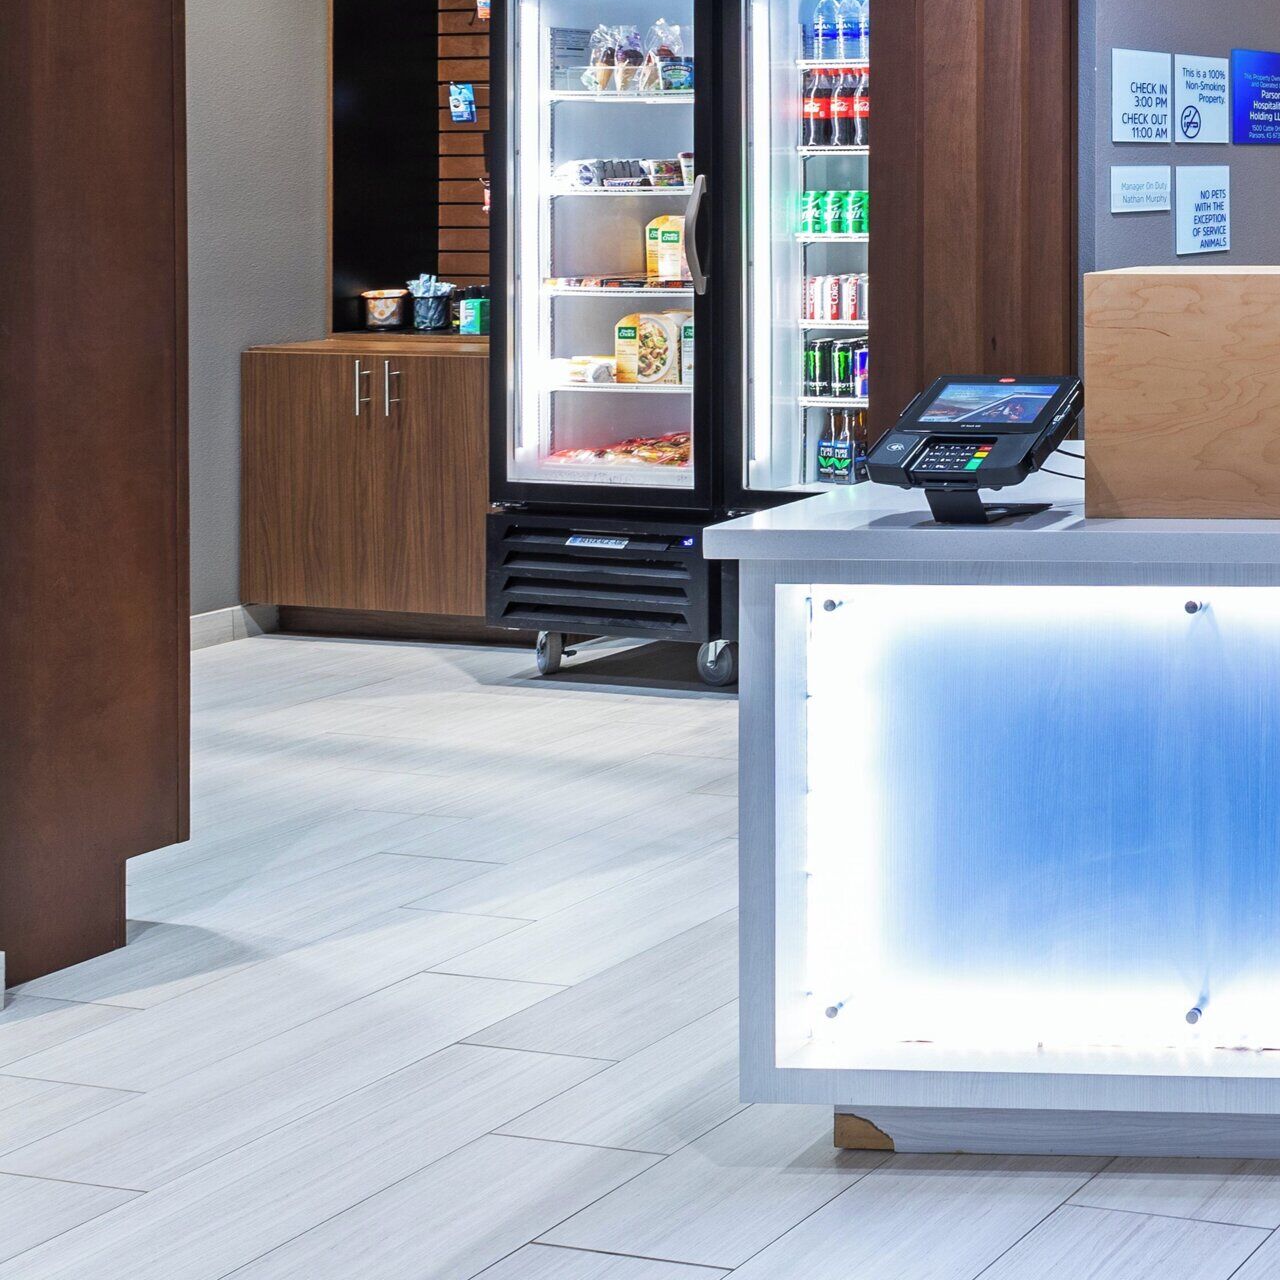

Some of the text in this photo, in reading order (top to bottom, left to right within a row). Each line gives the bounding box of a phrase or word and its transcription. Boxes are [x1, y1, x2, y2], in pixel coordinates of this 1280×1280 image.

[1182, 67, 1226, 80] This is a 100%
[1130, 81, 1168, 95] CHECK IN
[1185, 80, 1226, 93] Non-Smoking
[1134, 96, 1168, 108] 3:00 PM
[1121, 112, 1168, 125] CHECK OUT
[1249, 111, 1273, 122] Holding
[1131, 127, 1168, 138] 11:00 AM
[1121, 181, 1167, 192] Manager On Duty
[1122, 193, 1167, 204] Nathan Murphy
[1200, 189, 1226, 200] NO PETS
[1194, 201, 1224, 212] WITH THE
[1193, 213, 1226, 225] EXCEPTION
[1192, 225, 1226, 237] OF SERVICE
[1200, 237, 1227, 248] ANIMALS
